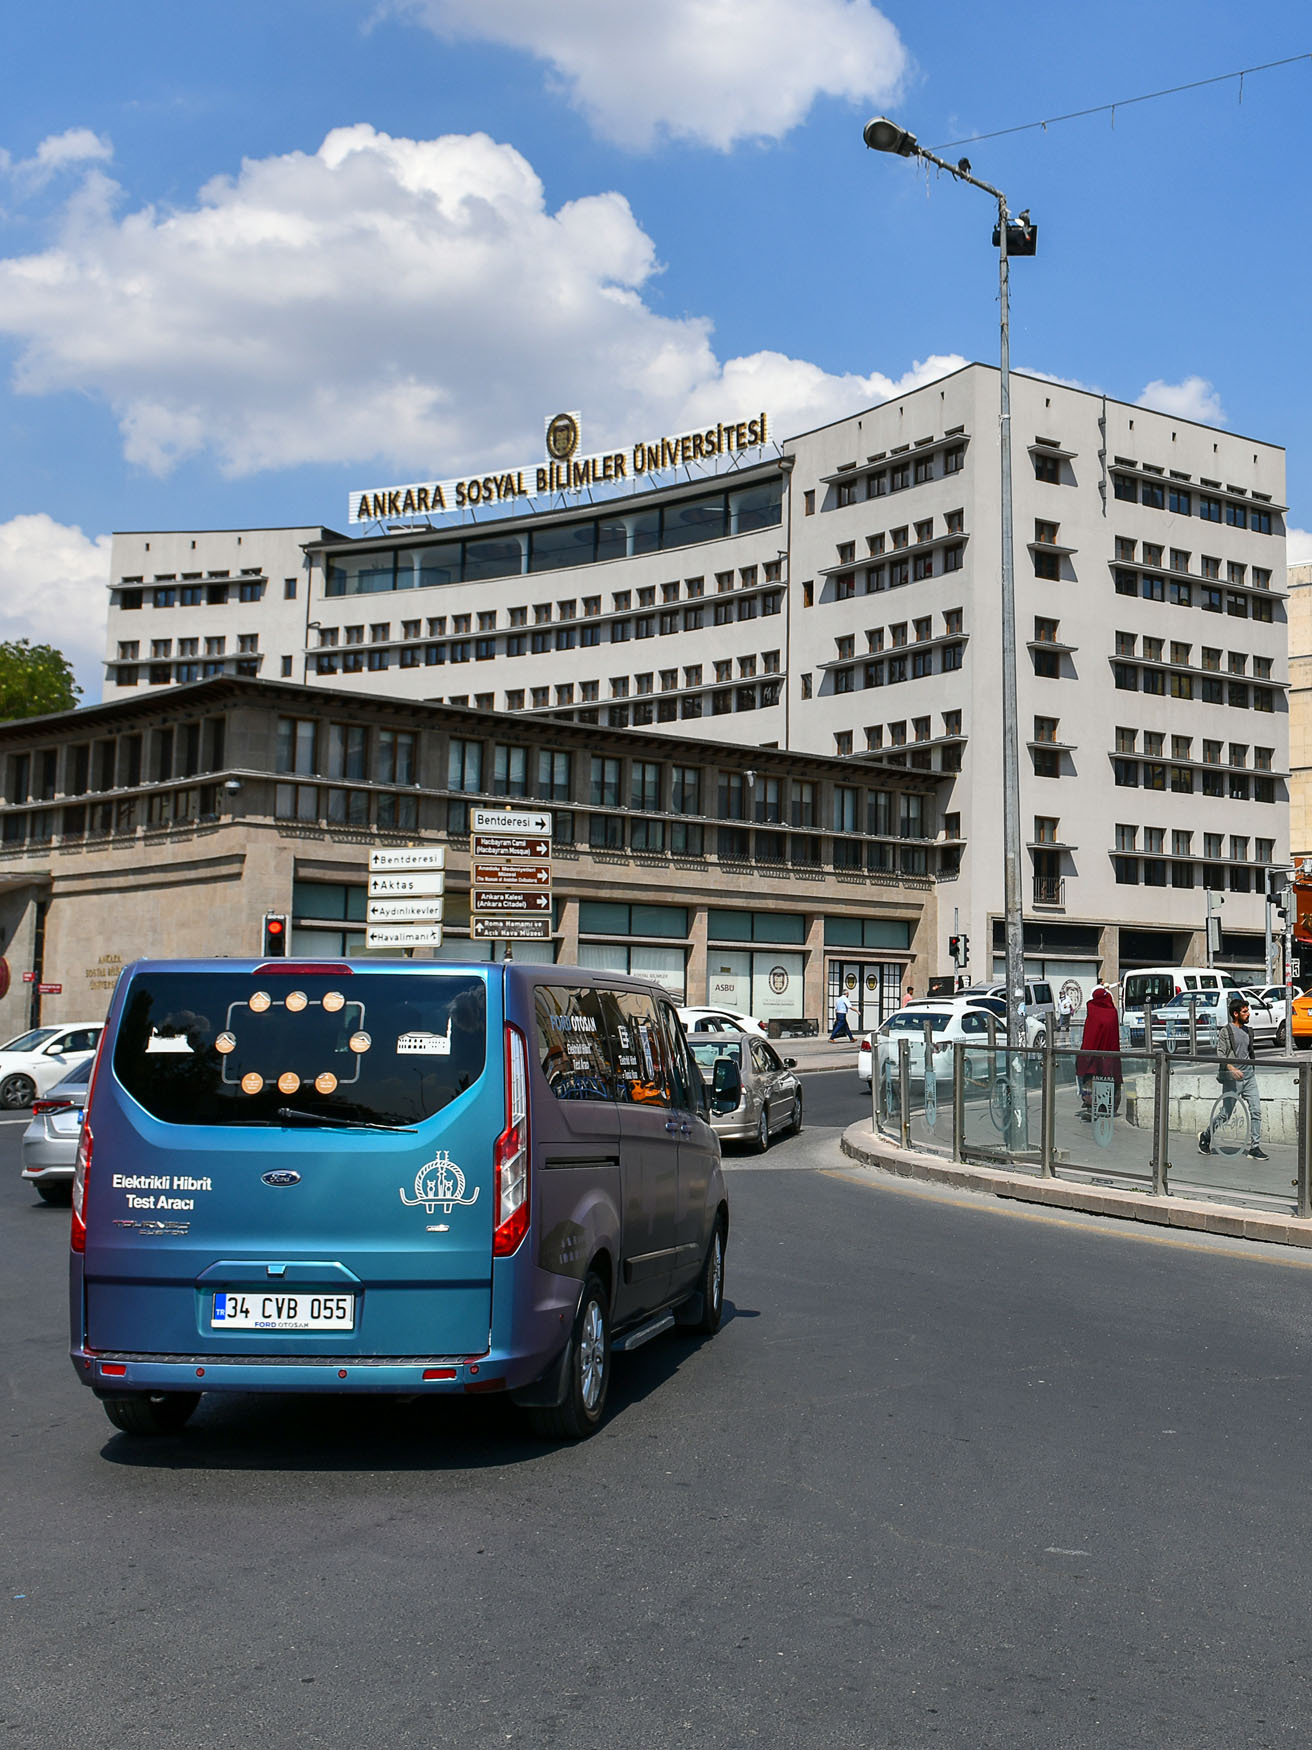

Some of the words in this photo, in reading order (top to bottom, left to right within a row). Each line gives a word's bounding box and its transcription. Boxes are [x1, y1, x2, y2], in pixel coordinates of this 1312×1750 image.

[357, 485, 447, 519] ANKARA
[455, 471, 528, 507] SOSYAL
[536, 458, 627, 492] BİLİMLER
[633, 412, 768, 473] ÜNİVERSİTESİ
[477, 815, 530, 827] Bentderesi
[380, 854, 437, 864] Bentderesi
[380, 880, 414, 890] Aktaş
[379, 905, 439, 917] Aydınlıkevler
[377, 932, 429, 942] Havalimanı
[550, 1015, 572, 1032] FORD
[571, 1015, 597, 1032] OTOSAN
[112, 1174, 170, 1190] Elektrikli
[173, 1176, 212, 1191] Hibrit
[269, 1173, 292, 1183] Ford
[126, 1194, 155, 1209] Test
[156, 1196, 194, 1210] Aracı
[227, 1297, 250, 1318] 34
[262, 1297, 298, 1319] CVB
[310, 1298, 347, 1319] 055
